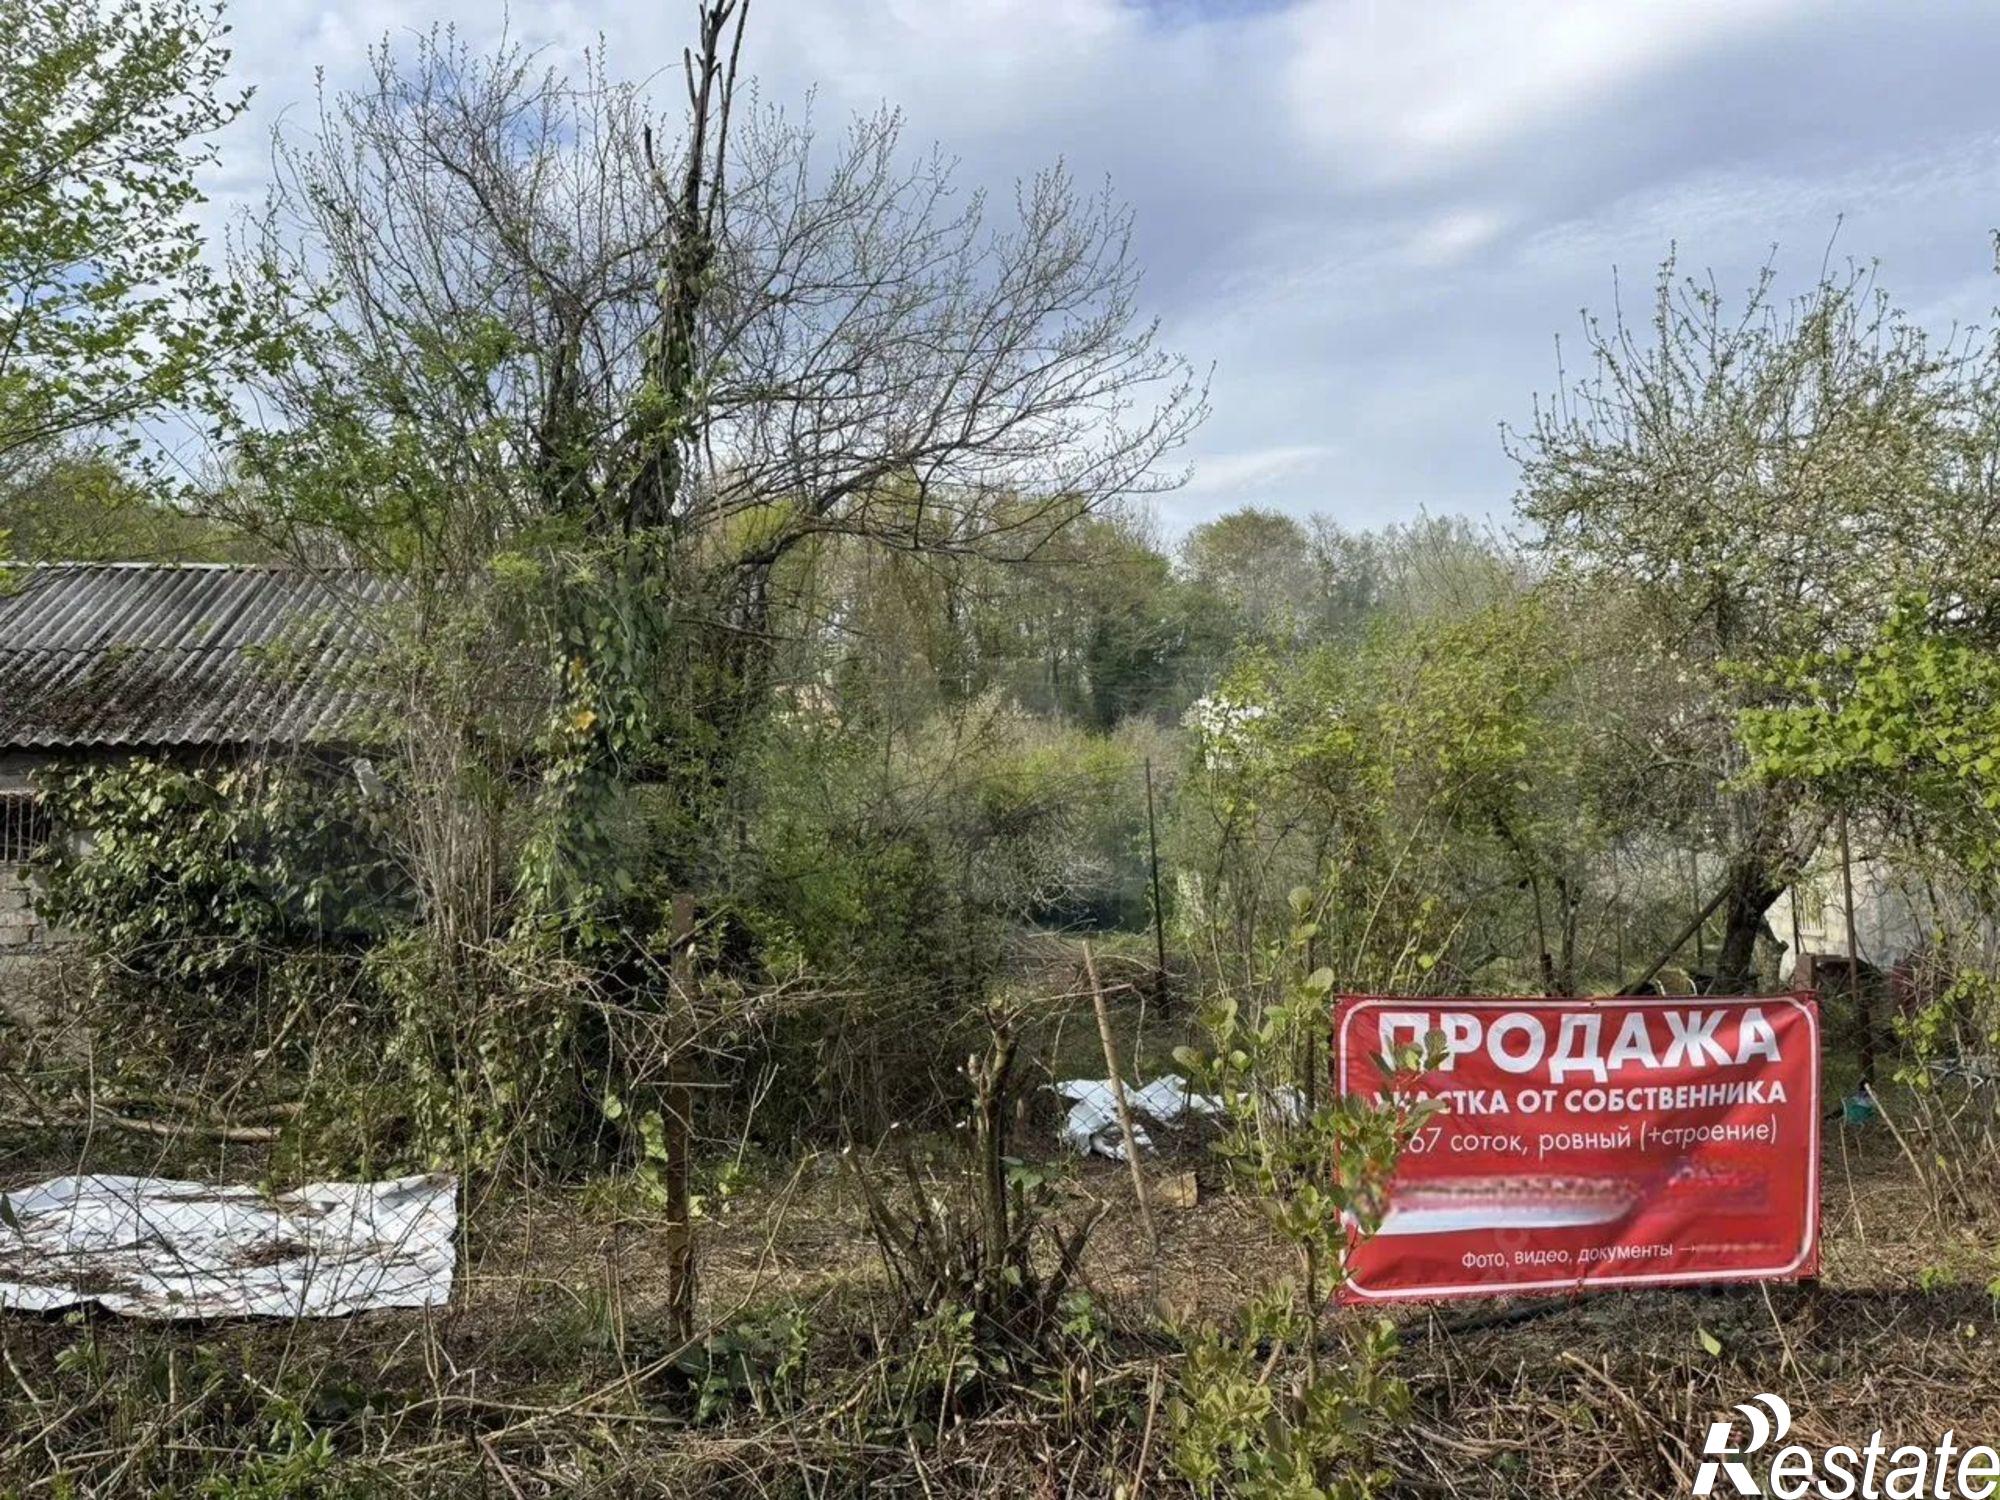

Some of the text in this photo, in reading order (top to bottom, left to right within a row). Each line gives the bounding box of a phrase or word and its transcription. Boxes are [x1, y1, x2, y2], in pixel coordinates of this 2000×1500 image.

[1379, 1007, 1781, 1084] ПРОДАЖА
[1516, 1089, 1558, 1114] ОТ
[1564, 1082, 1787, 1114] СОБСТВЕННИКА
[1450, 1135, 1527, 1156] соток,
[1539, 1125, 1631, 1160] ровный
[1640, 1114, 1777, 1152] (+строение)
[1462, 1252, 1510, 1270] Фото,
[1514, 1249, 1573, 1267] видео,
[1577, 1242, 1673, 1264] документы
